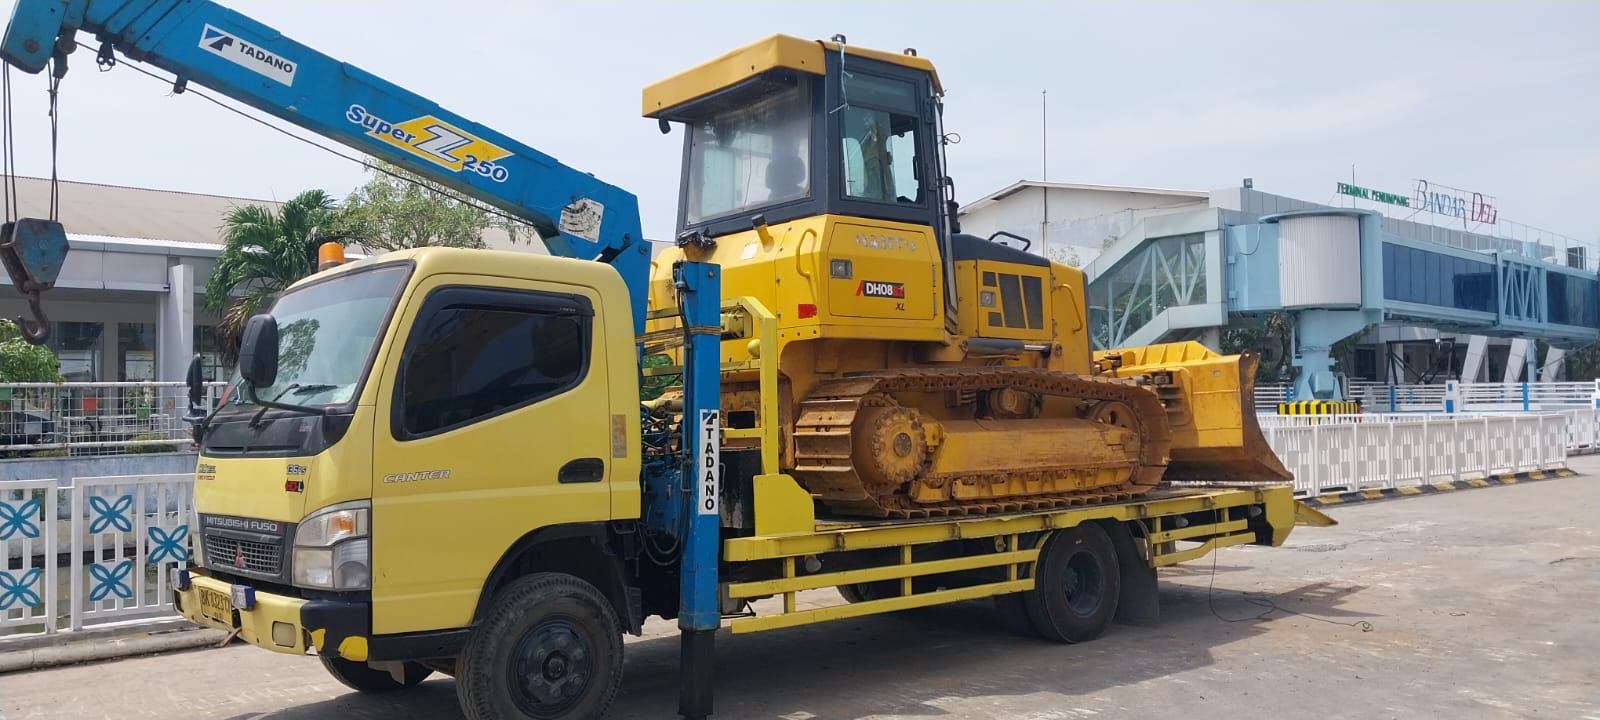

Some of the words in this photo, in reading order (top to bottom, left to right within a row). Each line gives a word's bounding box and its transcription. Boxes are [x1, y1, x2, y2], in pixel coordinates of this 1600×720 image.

[240, 42, 293, 73] TADANO
[346, 104, 416, 144] Super
[462, 154, 508, 182] 250
[1336, 182, 1369, 199] TERMINAL
[1372, 190, 1410, 207] PENUMPANG
[1416, 179, 1467, 229] BANDAR
[896, 302, 904, 311] XL
[383, 469, 450, 483] CANTER
[704, 428, 714, 510] TADANO
[206, 516, 248, 529] MITSUBISHI
[251, 520, 278, 532] FUSO
